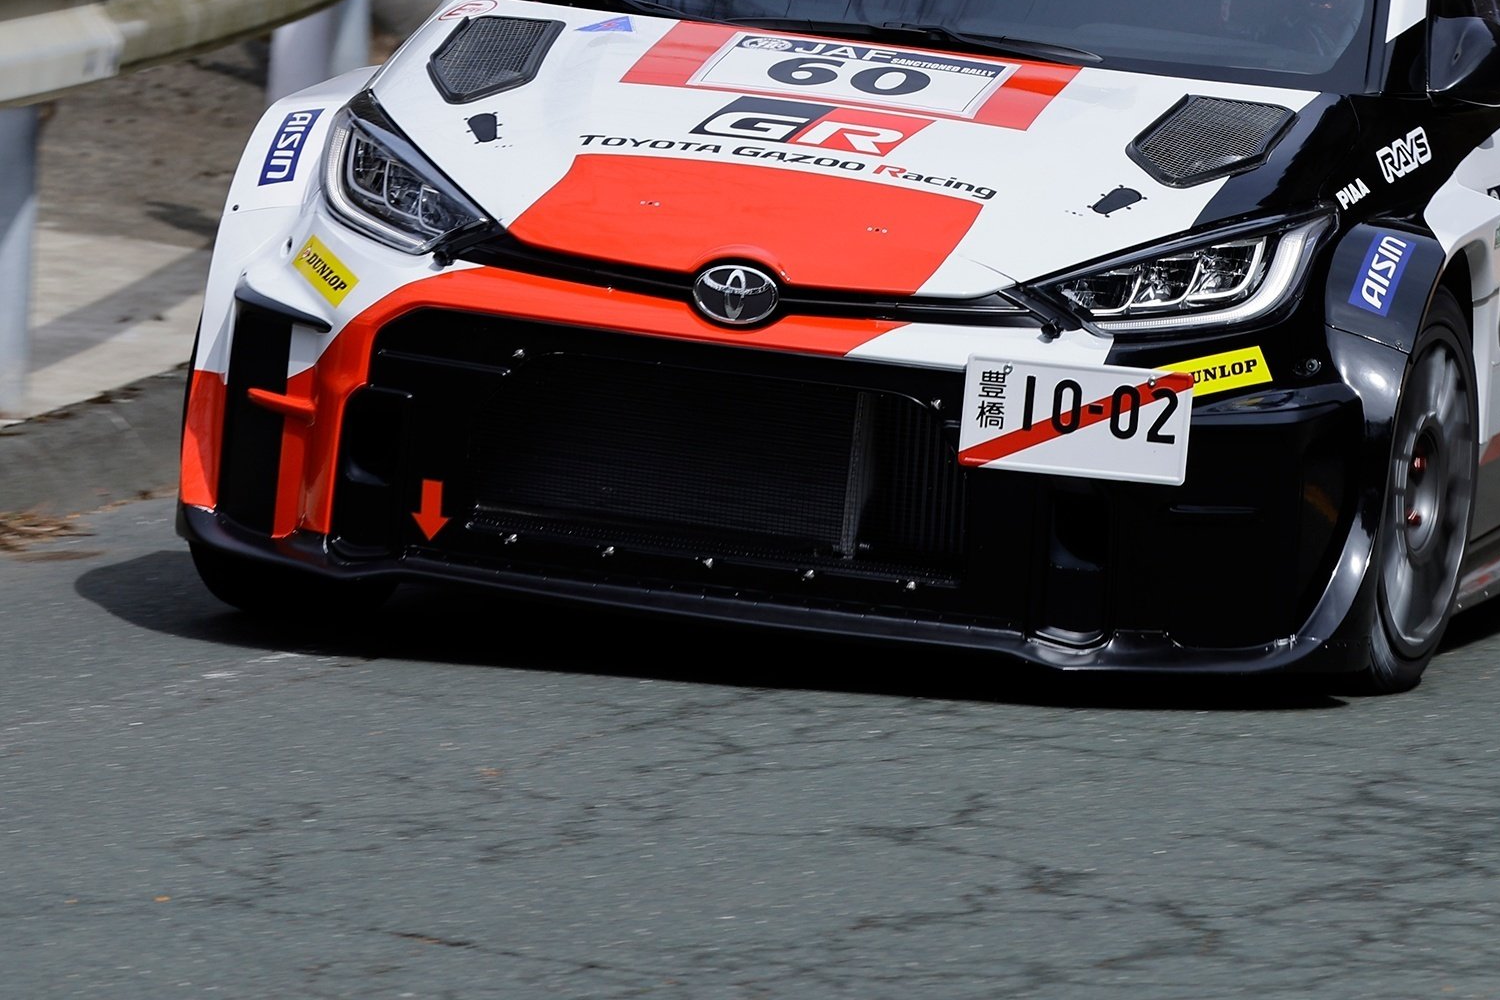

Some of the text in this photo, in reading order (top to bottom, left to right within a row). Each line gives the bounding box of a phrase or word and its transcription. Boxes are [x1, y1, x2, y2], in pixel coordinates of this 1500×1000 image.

[795, 43, 899, 62] JAF
[890, 57, 996, 78] SANCTIONED RALLY
[767, 57, 931, 96] 60
[266, 112, 313, 179] AISIN
[703, 111, 904, 155] GR
[1376, 126, 1432, 184] RAYS
[579, 134, 998, 200] TOYOTA GAZOO Racing
[1336, 178, 1371, 210] PIAA
[307, 253, 347, 291] DUNLOP
[1361, 236, 1407, 309] AISIN
[1190, 359, 1258, 384] UNLOP
[976, 370, 1007, 430] 豊橋
[1022, 375, 1180, 445] 10-02
